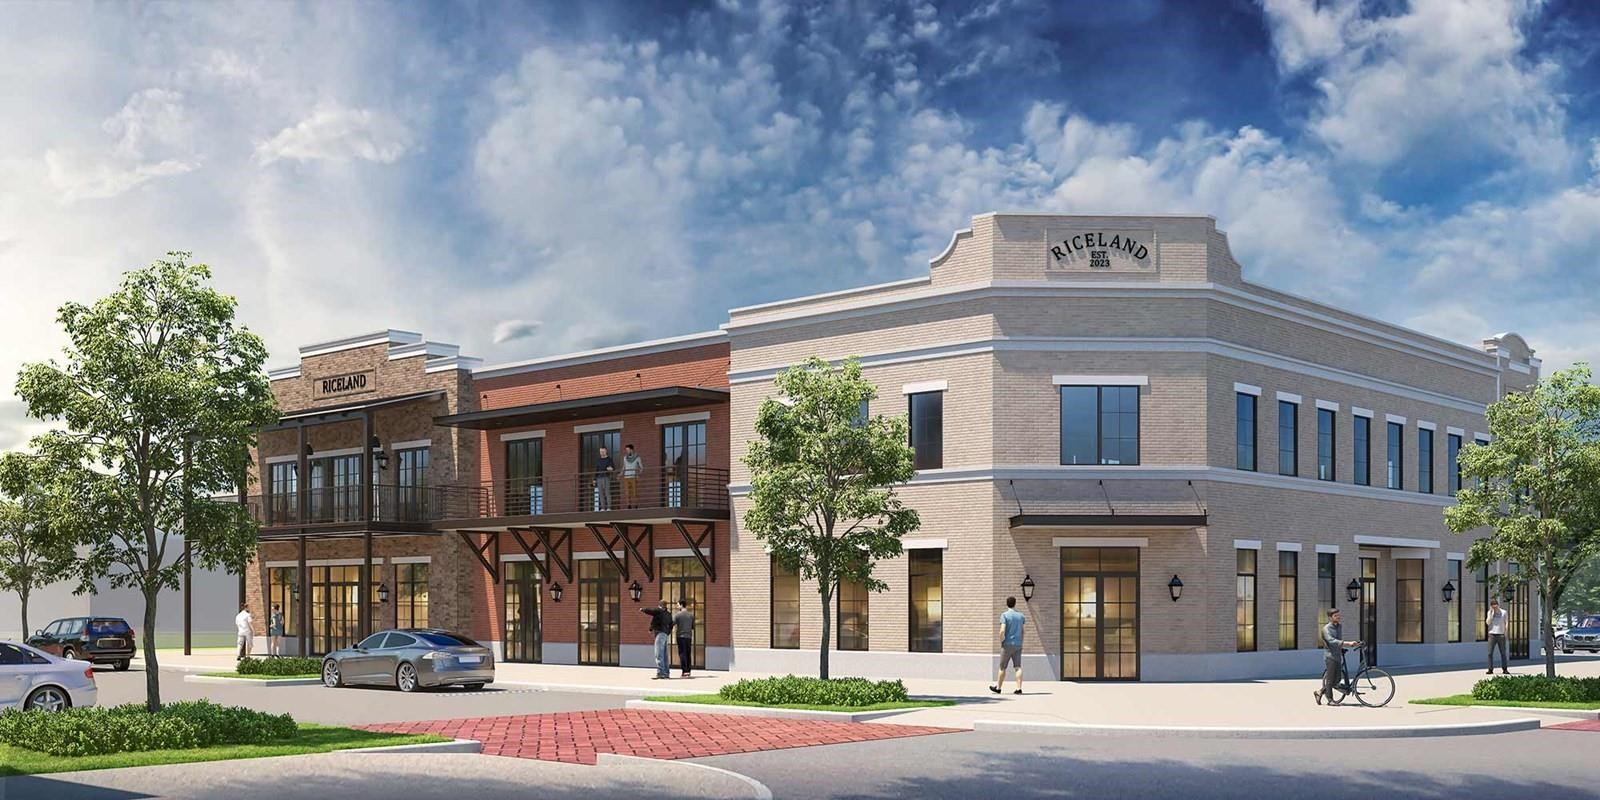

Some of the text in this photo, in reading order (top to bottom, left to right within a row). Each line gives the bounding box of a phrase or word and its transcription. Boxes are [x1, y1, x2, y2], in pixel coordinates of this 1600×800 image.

[1051, 232, 1148, 261] RICELAND
[1091, 250, 1109, 259] EST.
[1089, 259, 1110, 267] 2023
[322, 374, 367, 394] RICELAND
